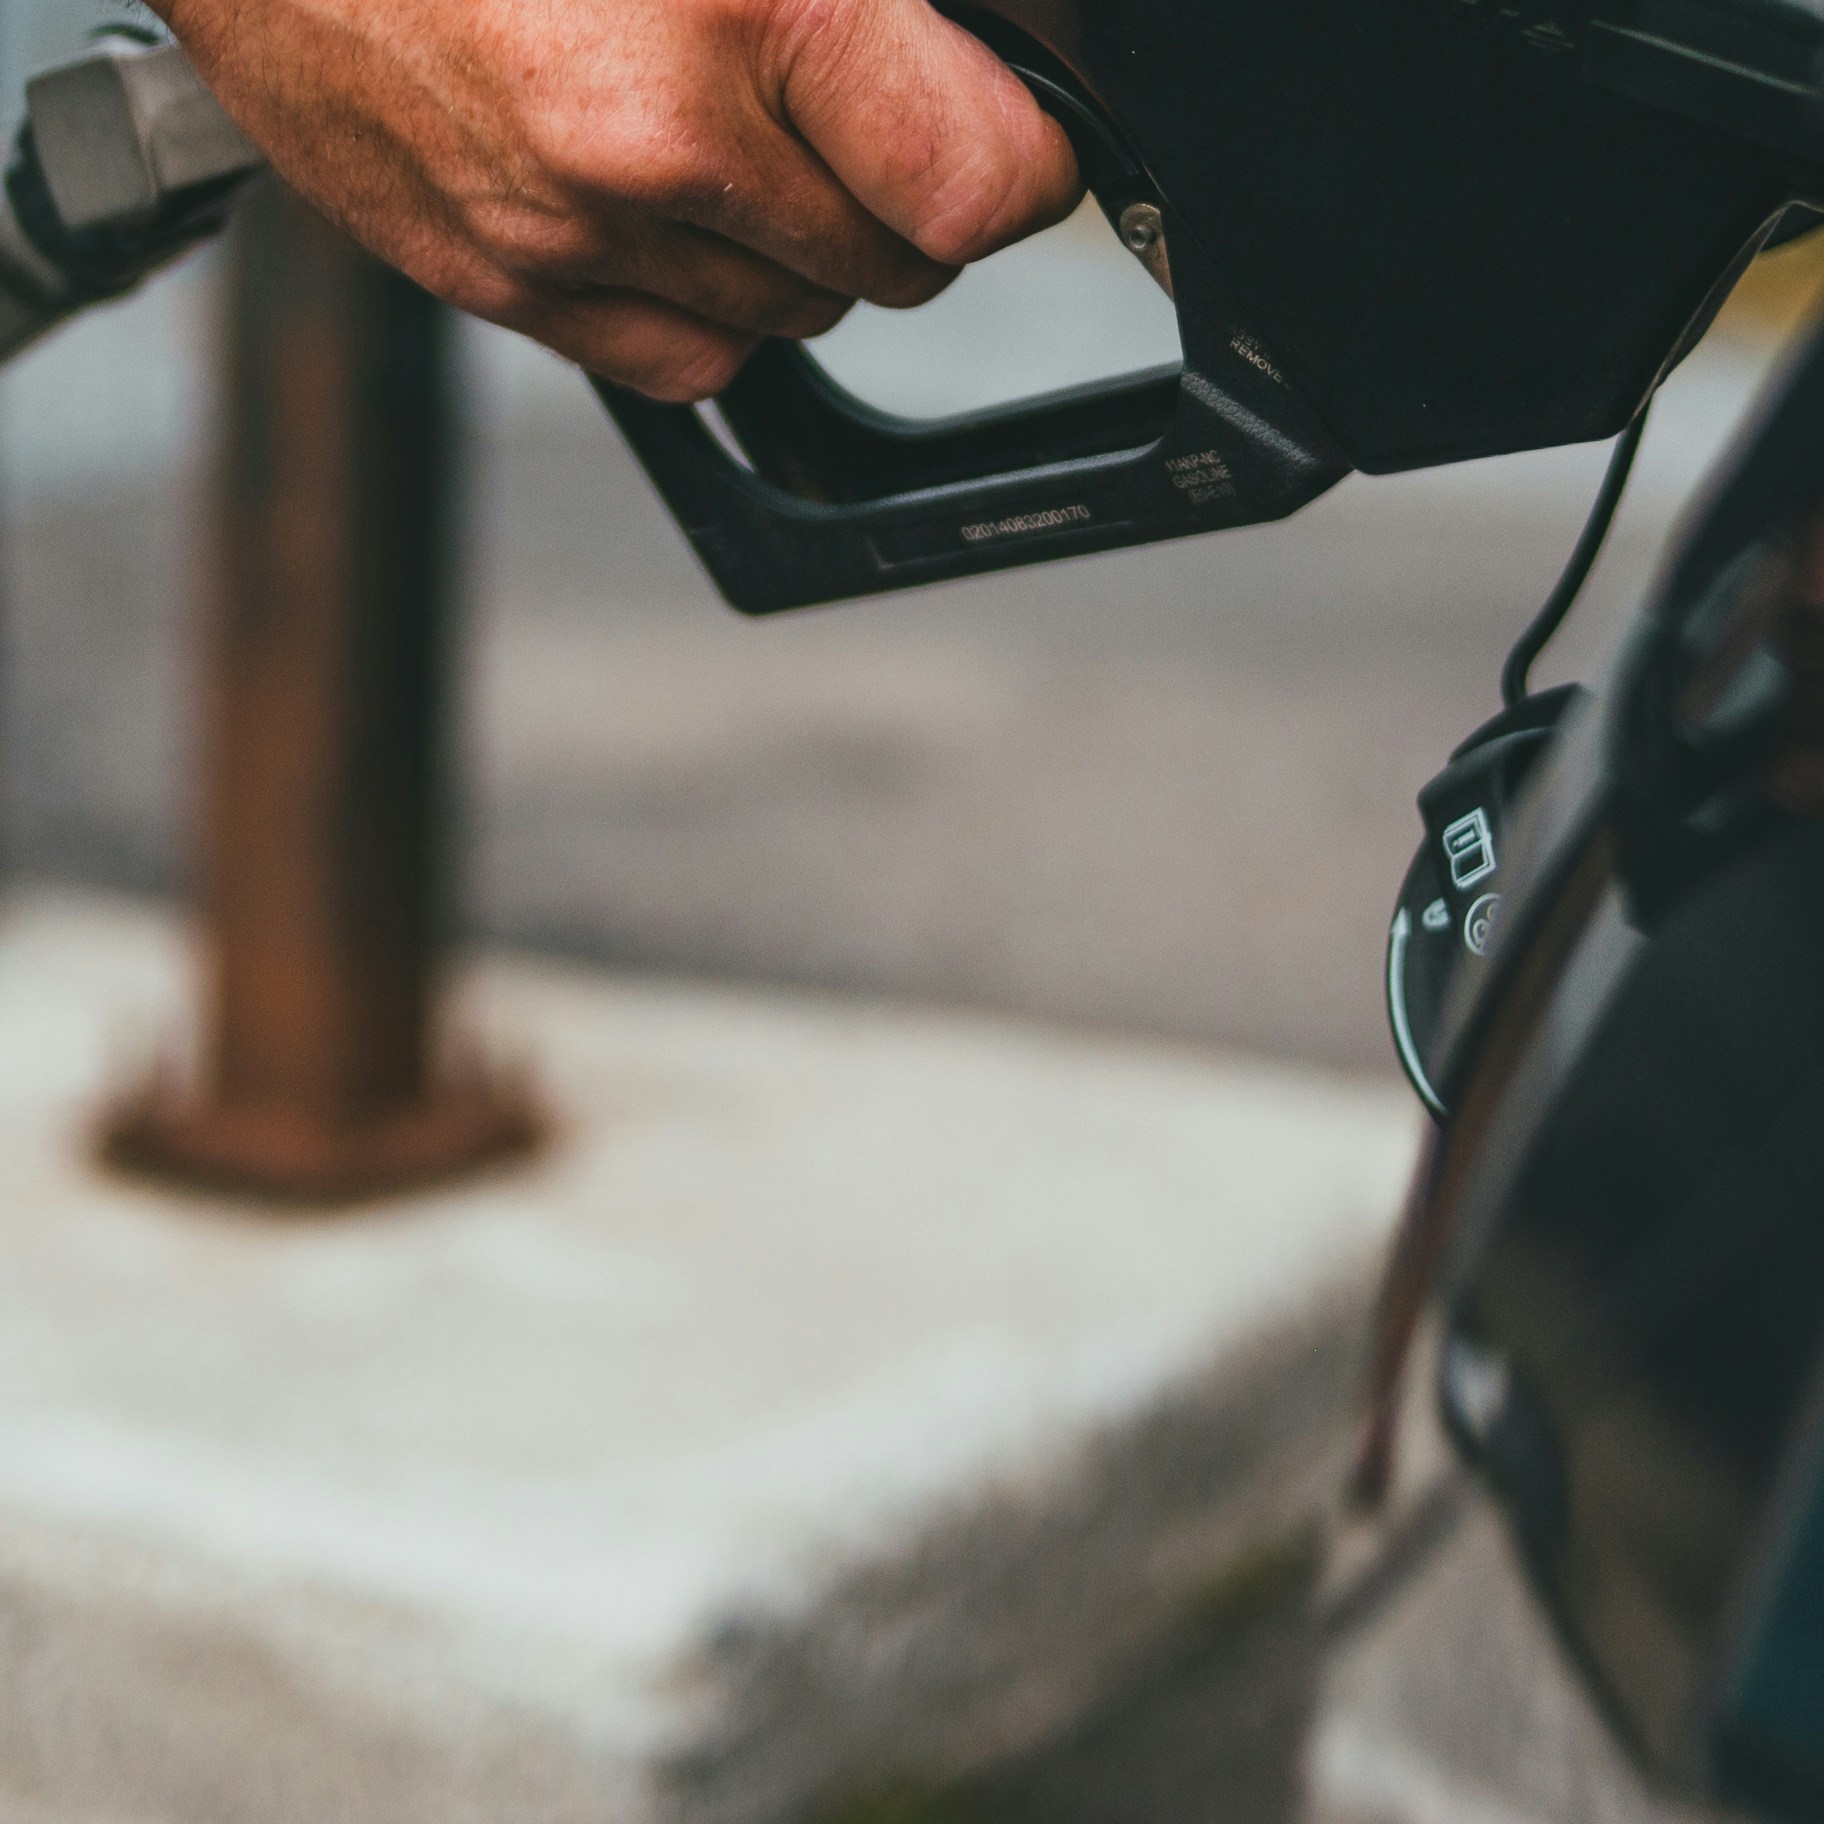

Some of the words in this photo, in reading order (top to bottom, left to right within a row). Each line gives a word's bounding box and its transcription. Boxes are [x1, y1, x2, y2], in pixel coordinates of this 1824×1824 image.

[1230, 337, 1282, 383] REMOVE
[1173, 465, 1232, 488] GASOLINE
[962, 504, 1091, 540] 02014083200170
